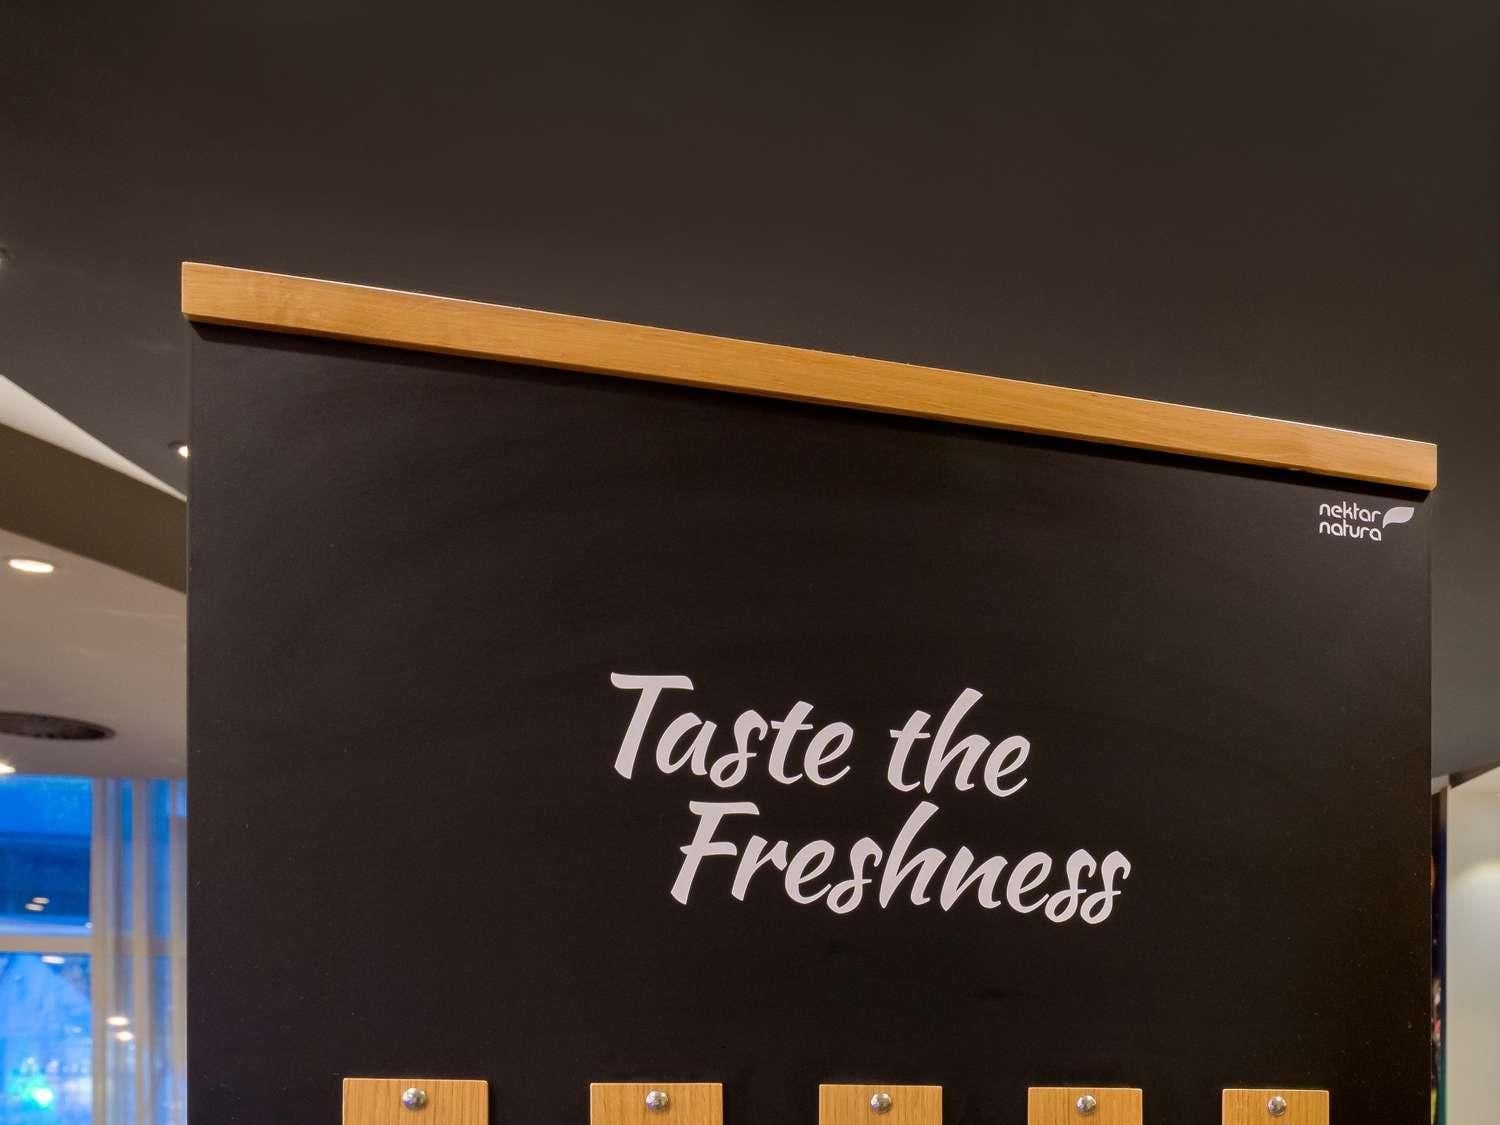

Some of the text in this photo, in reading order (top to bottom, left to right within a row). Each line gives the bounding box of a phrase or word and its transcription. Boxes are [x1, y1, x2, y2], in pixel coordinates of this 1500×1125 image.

[1319, 501, 1381, 523] nektar
[1319, 519, 1382, 542] natura
[610, 671, 1031, 797] Taste the
[670, 800, 1132, 925] Freshness
